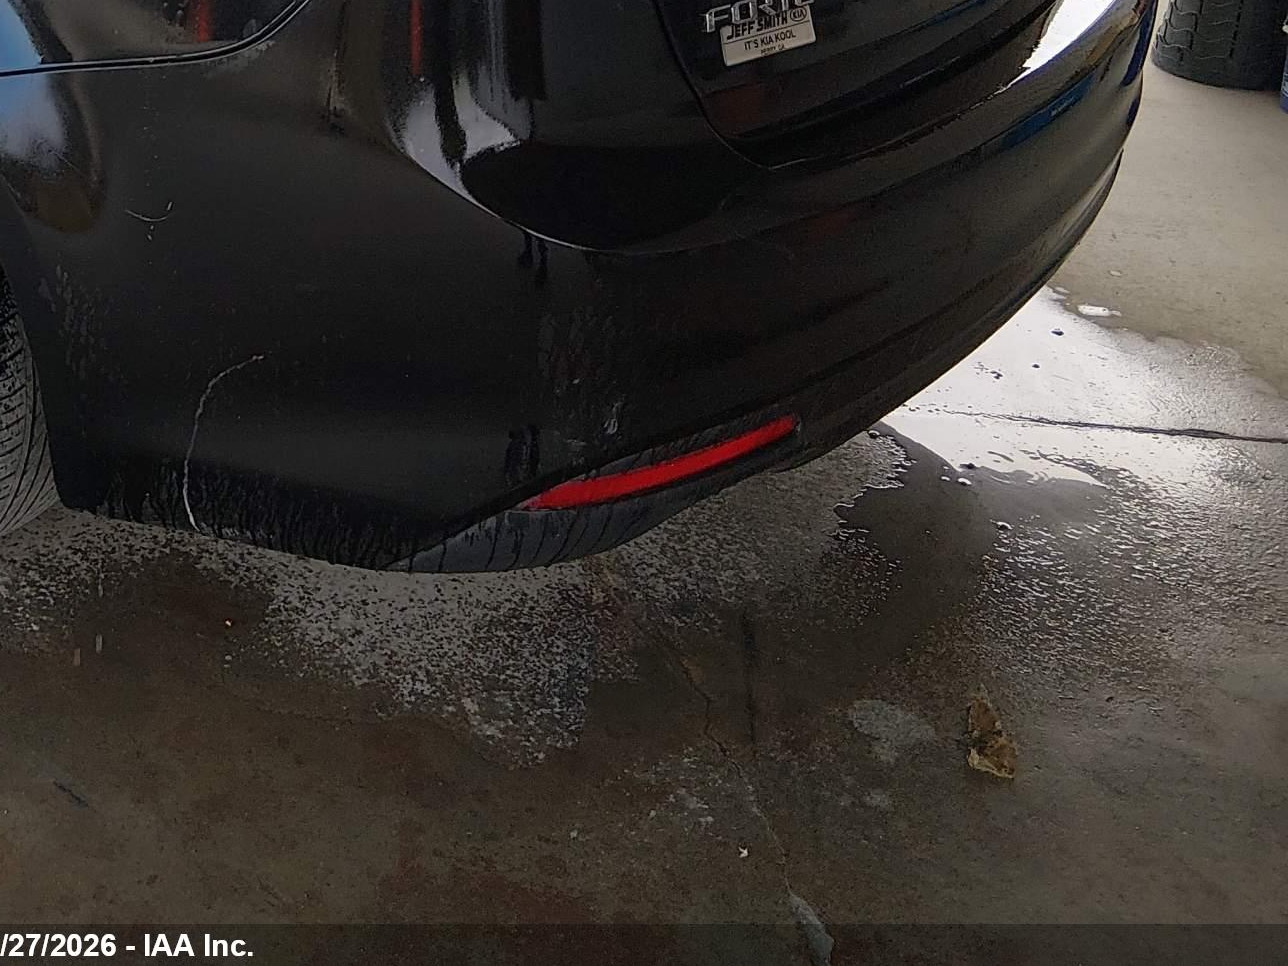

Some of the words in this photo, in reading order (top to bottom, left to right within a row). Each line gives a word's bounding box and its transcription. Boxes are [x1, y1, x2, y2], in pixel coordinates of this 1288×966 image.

[726, 20, 755, 40] JEFF
[756, 10, 789, 32] SMITH
[760, 35, 774, 46] KIA
[775, 29, 797, 42] KOOL
